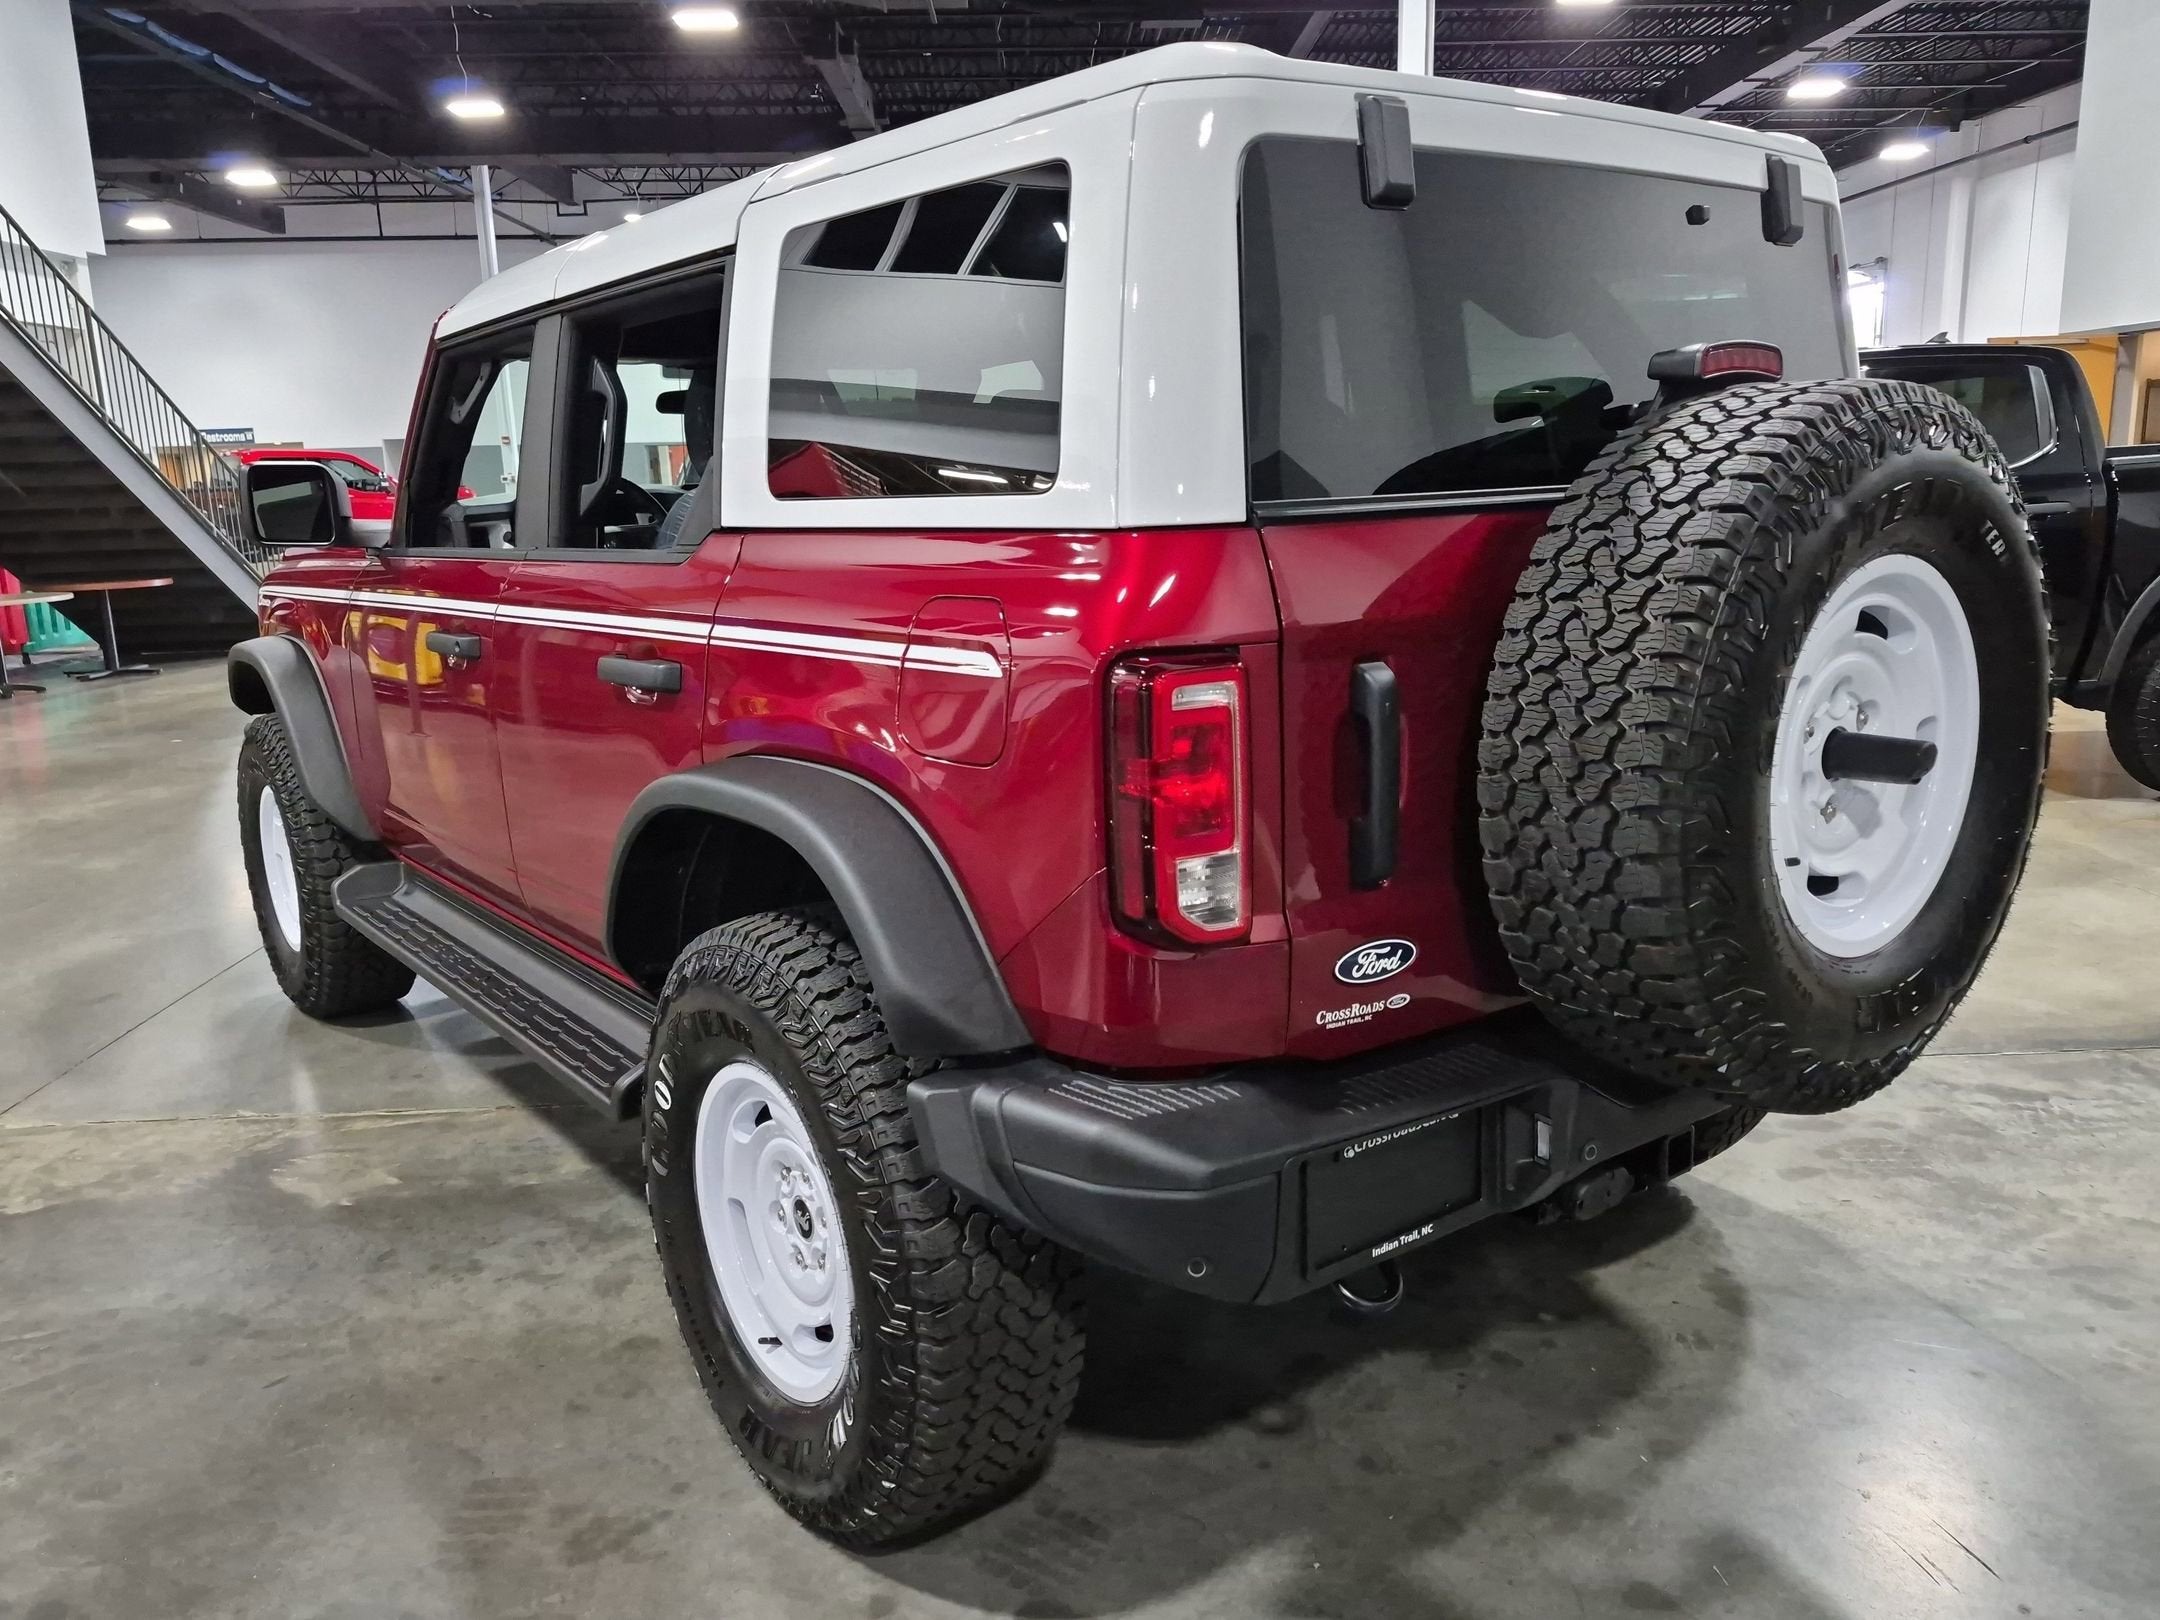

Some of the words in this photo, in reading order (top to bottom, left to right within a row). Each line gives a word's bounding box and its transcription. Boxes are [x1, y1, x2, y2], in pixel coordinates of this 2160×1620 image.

[1352, 946, 1402, 978] Ford
[1372, 1240, 1399, 1258] Indian
[1400, 1231, 1421, 1246] Trail,
[1421, 1223, 1434, 1236] NC
